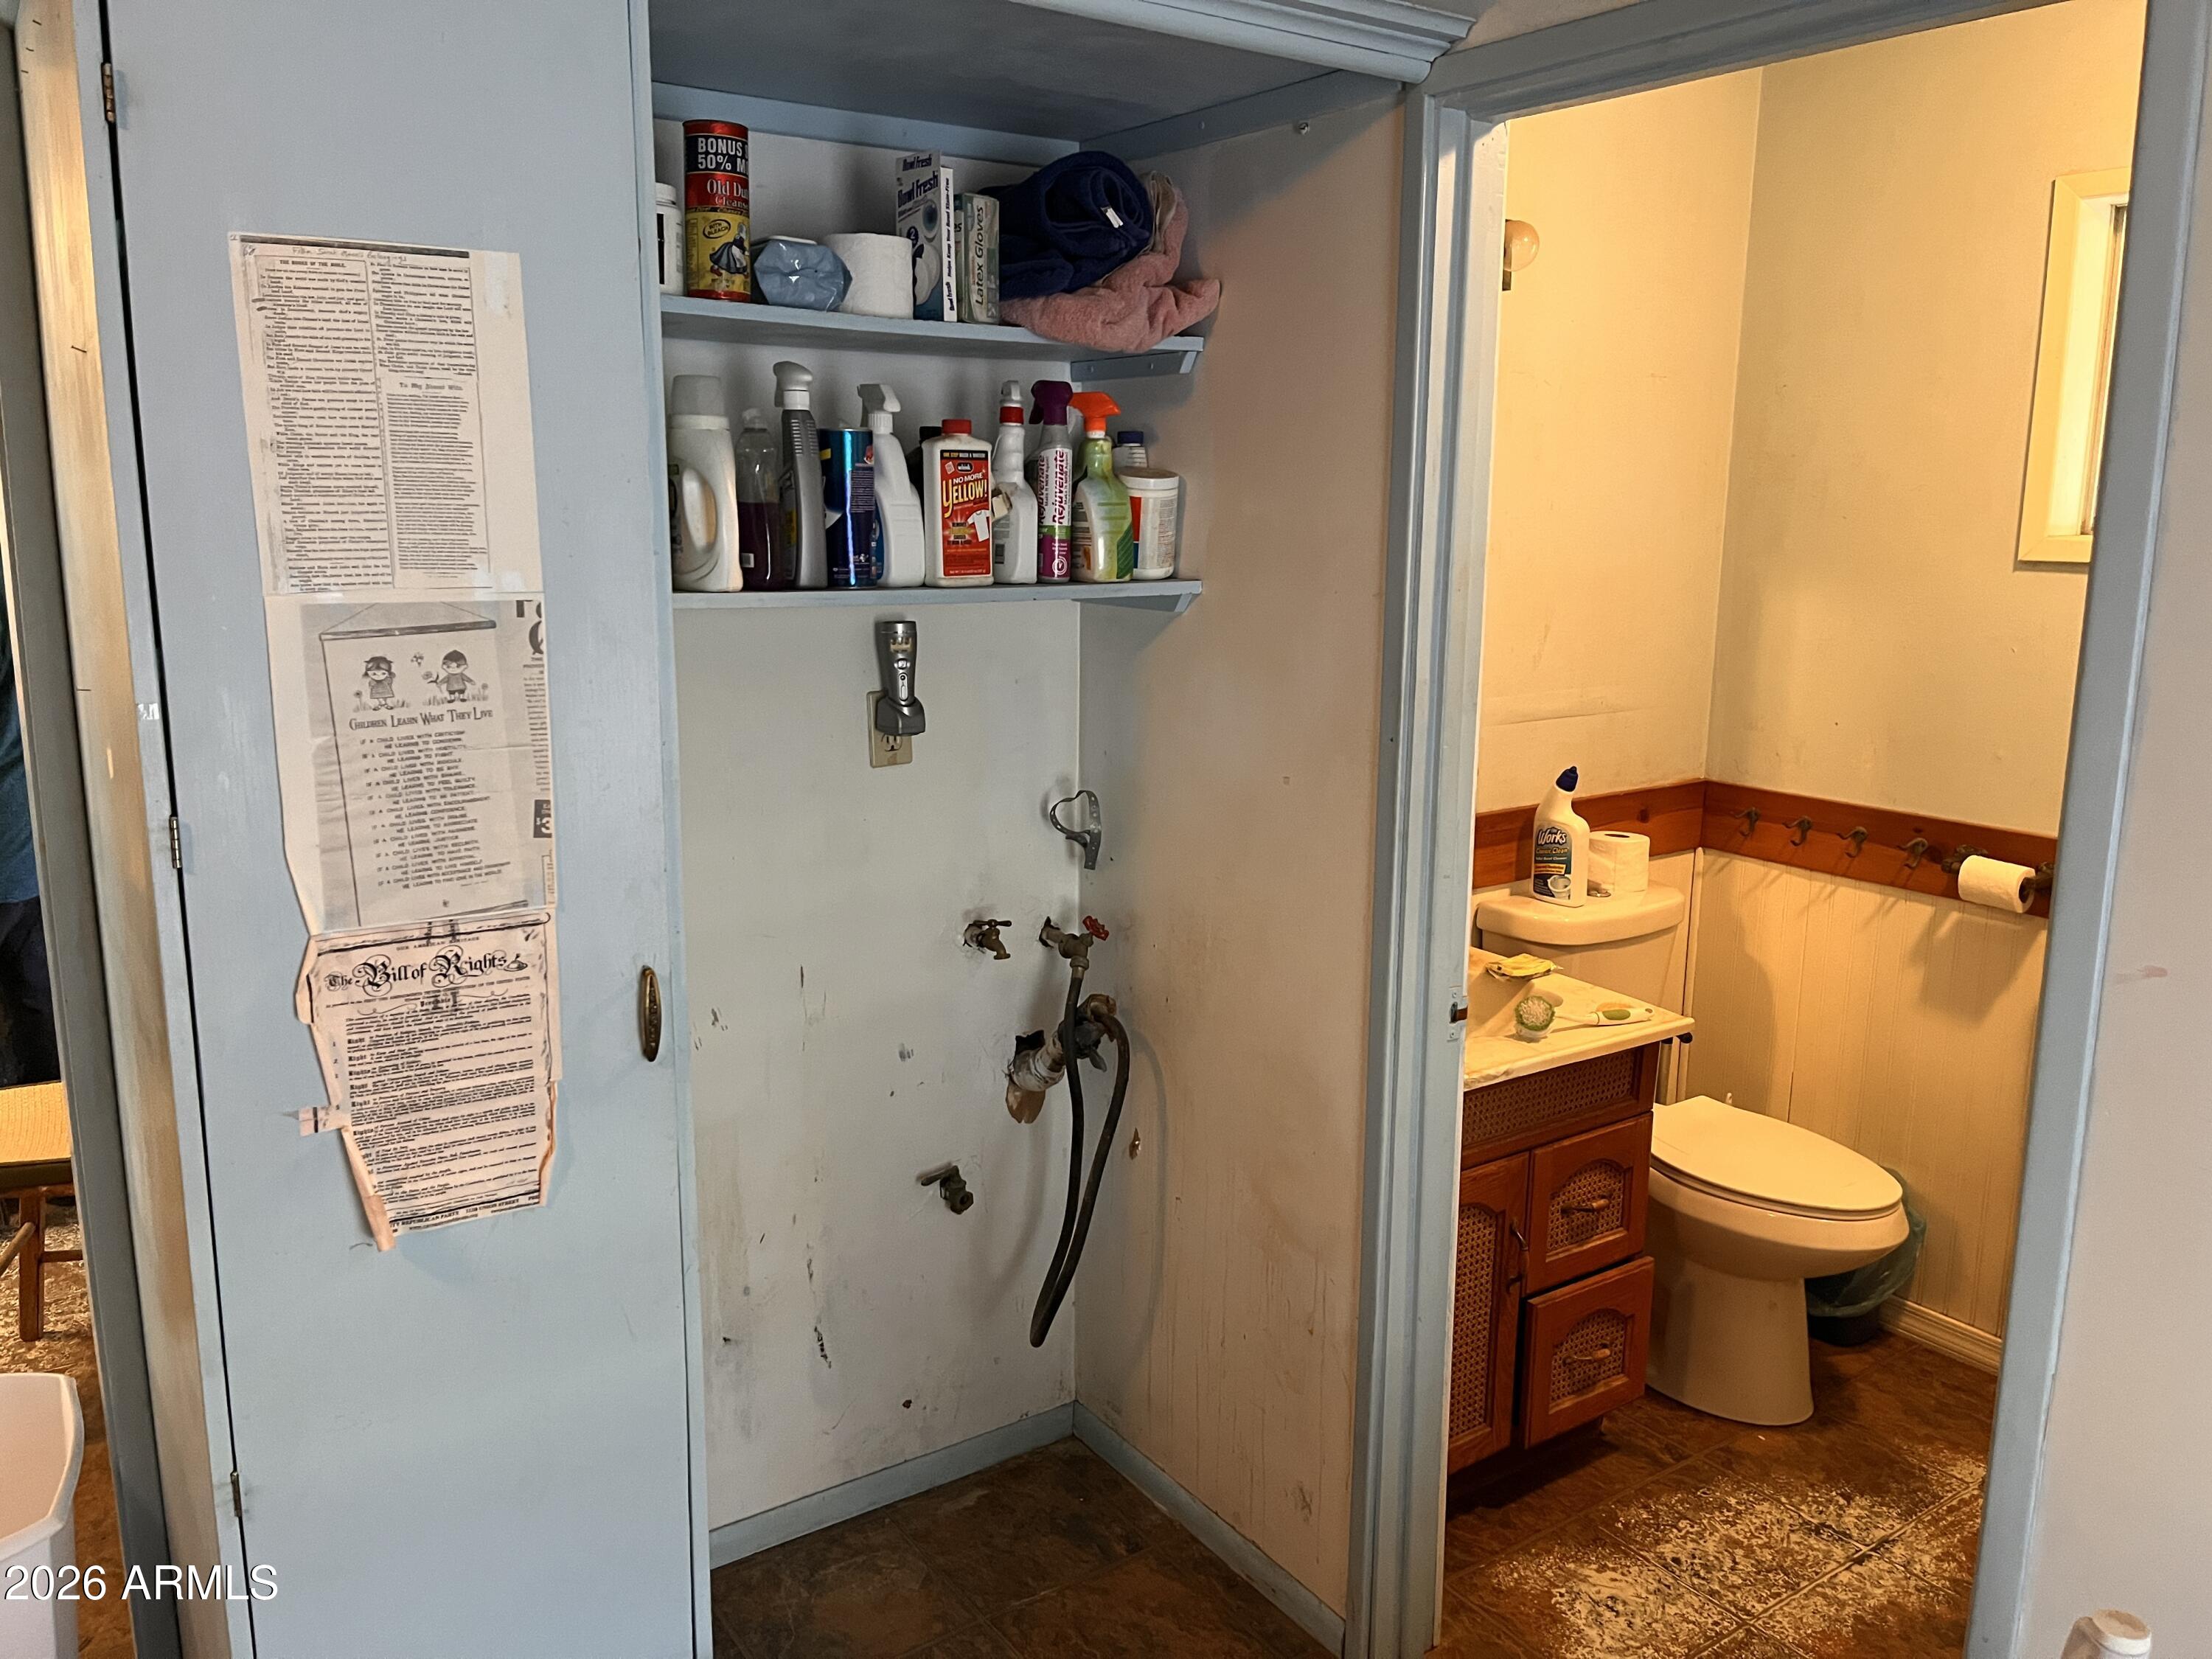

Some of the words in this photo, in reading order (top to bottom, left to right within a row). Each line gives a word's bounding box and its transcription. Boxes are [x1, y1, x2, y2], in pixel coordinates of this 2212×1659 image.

[698, 138, 742, 156] BONUS
[698, 154, 731, 170] 50%
[707, 178, 730, 196] Old
[916, 170, 938, 198] Fresh
[974, 206, 984, 259] Gloves
[975, 262, 984, 305] Latex
[953, 476, 964, 485] NO
[964, 472, 984, 481] MORE
[1052, 450, 1065, 524] Rejuvenate
[942, 479, 987, 518] YELLOW!
[1537, 827, 1567, 846] Works
[325, 970, 354, 992] The
[352, 954, 411, 997] Bill
[411, 962, 428, 985] of
[429, 945, 509, 988] Rights
[401, 1215, 439, 1225] REPUBLICAN
[440, 1211, 459, 1219] PARTY
